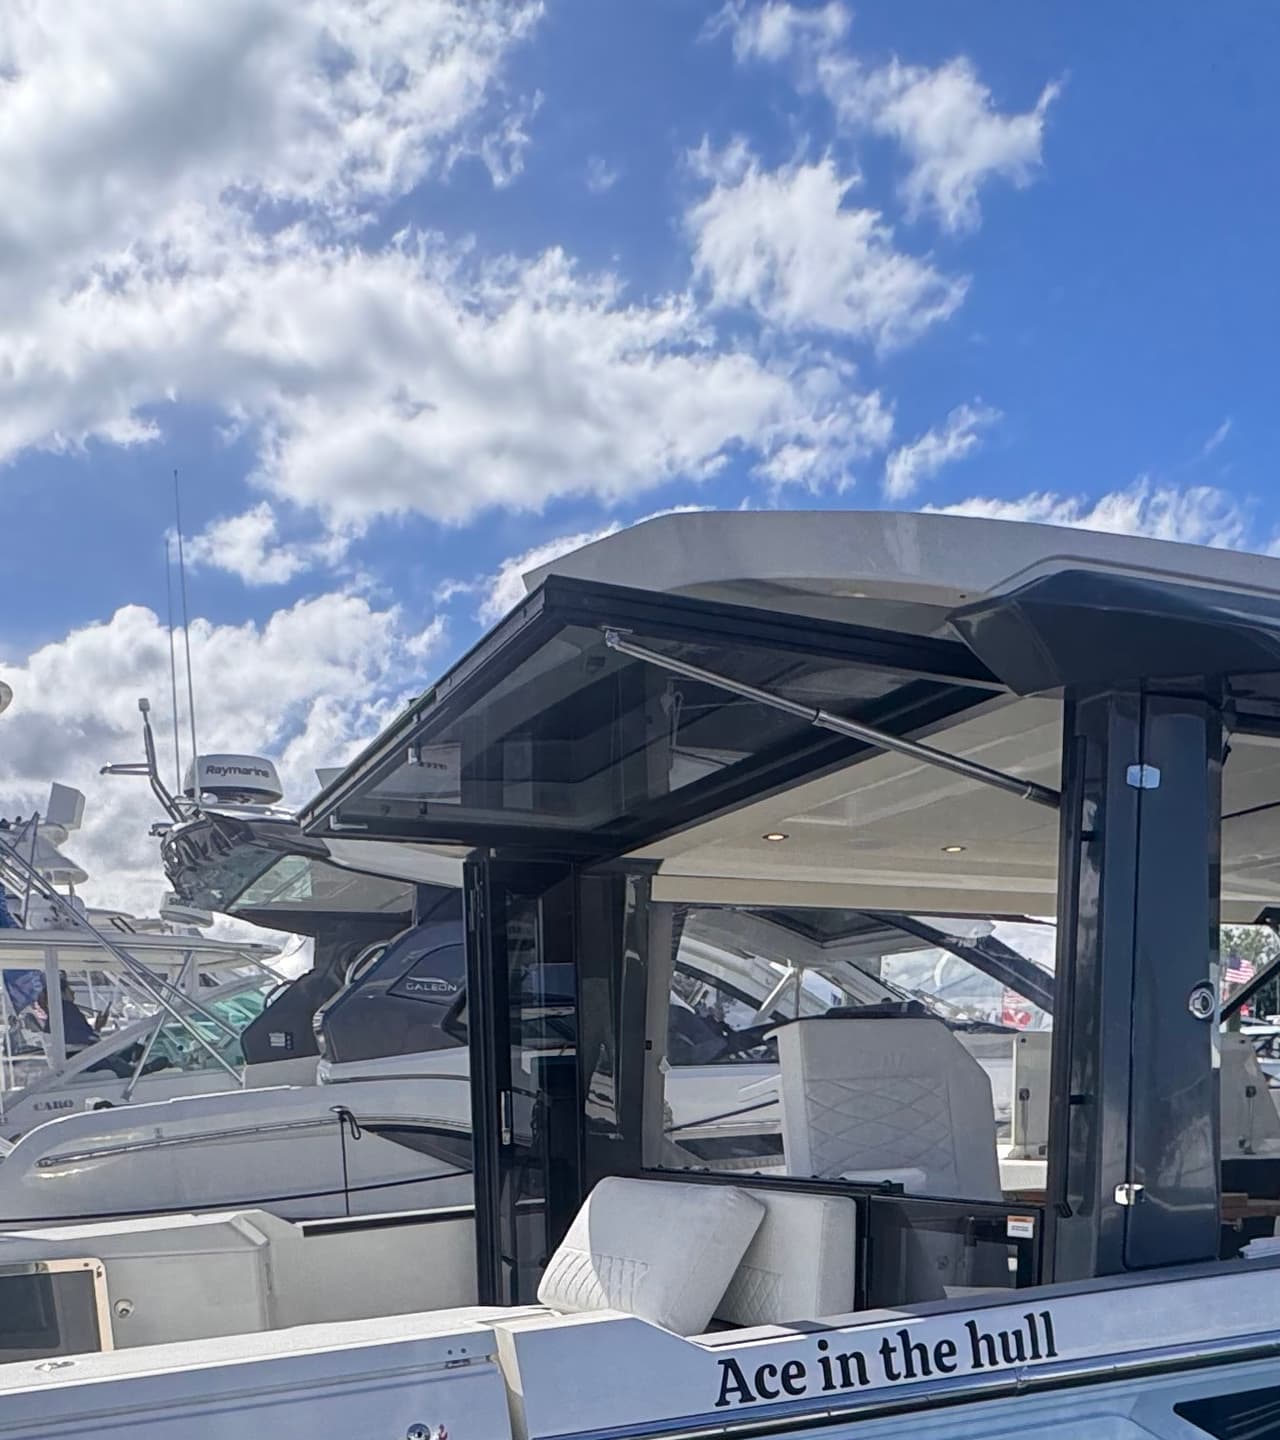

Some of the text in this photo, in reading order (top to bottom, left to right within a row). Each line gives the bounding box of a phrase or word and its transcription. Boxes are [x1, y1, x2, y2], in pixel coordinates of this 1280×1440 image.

[205, 764, 270, 778] Raymarine
[405, 982, 457, 992] GALEON
[714, 1310, 1059, 1407] Ace in the hull
